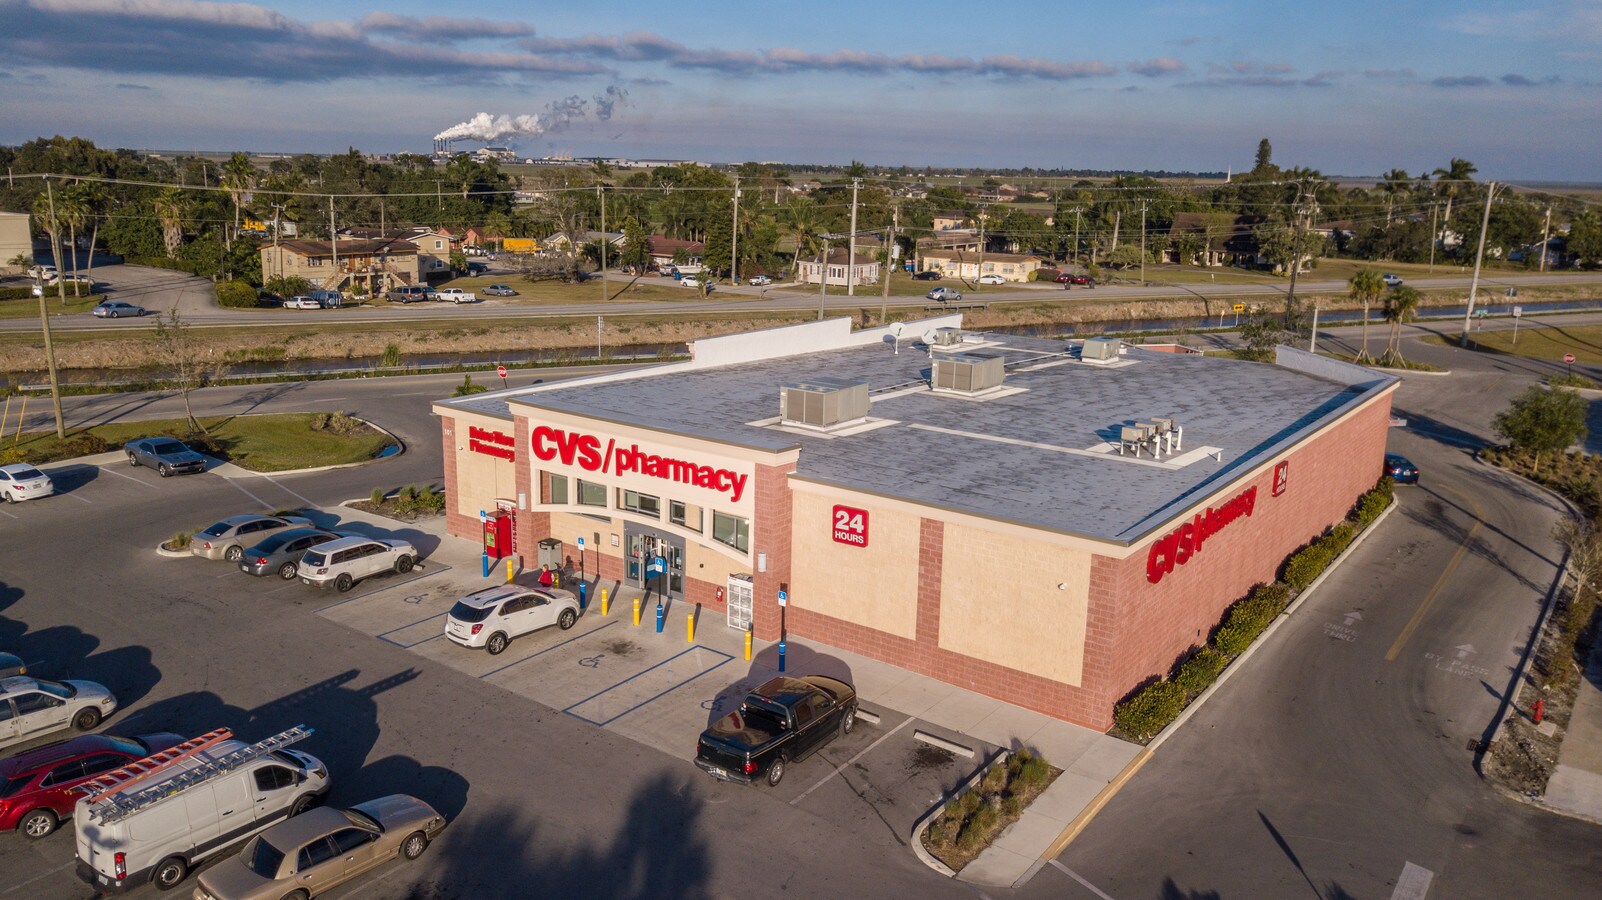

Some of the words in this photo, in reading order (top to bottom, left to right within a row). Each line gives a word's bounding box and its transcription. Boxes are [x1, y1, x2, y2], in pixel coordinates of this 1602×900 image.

[531, 426, 748, 503] CVS/pharmacy
[835, 511, 864, 533] 24
[835, 531, 864, 543] HOURS
